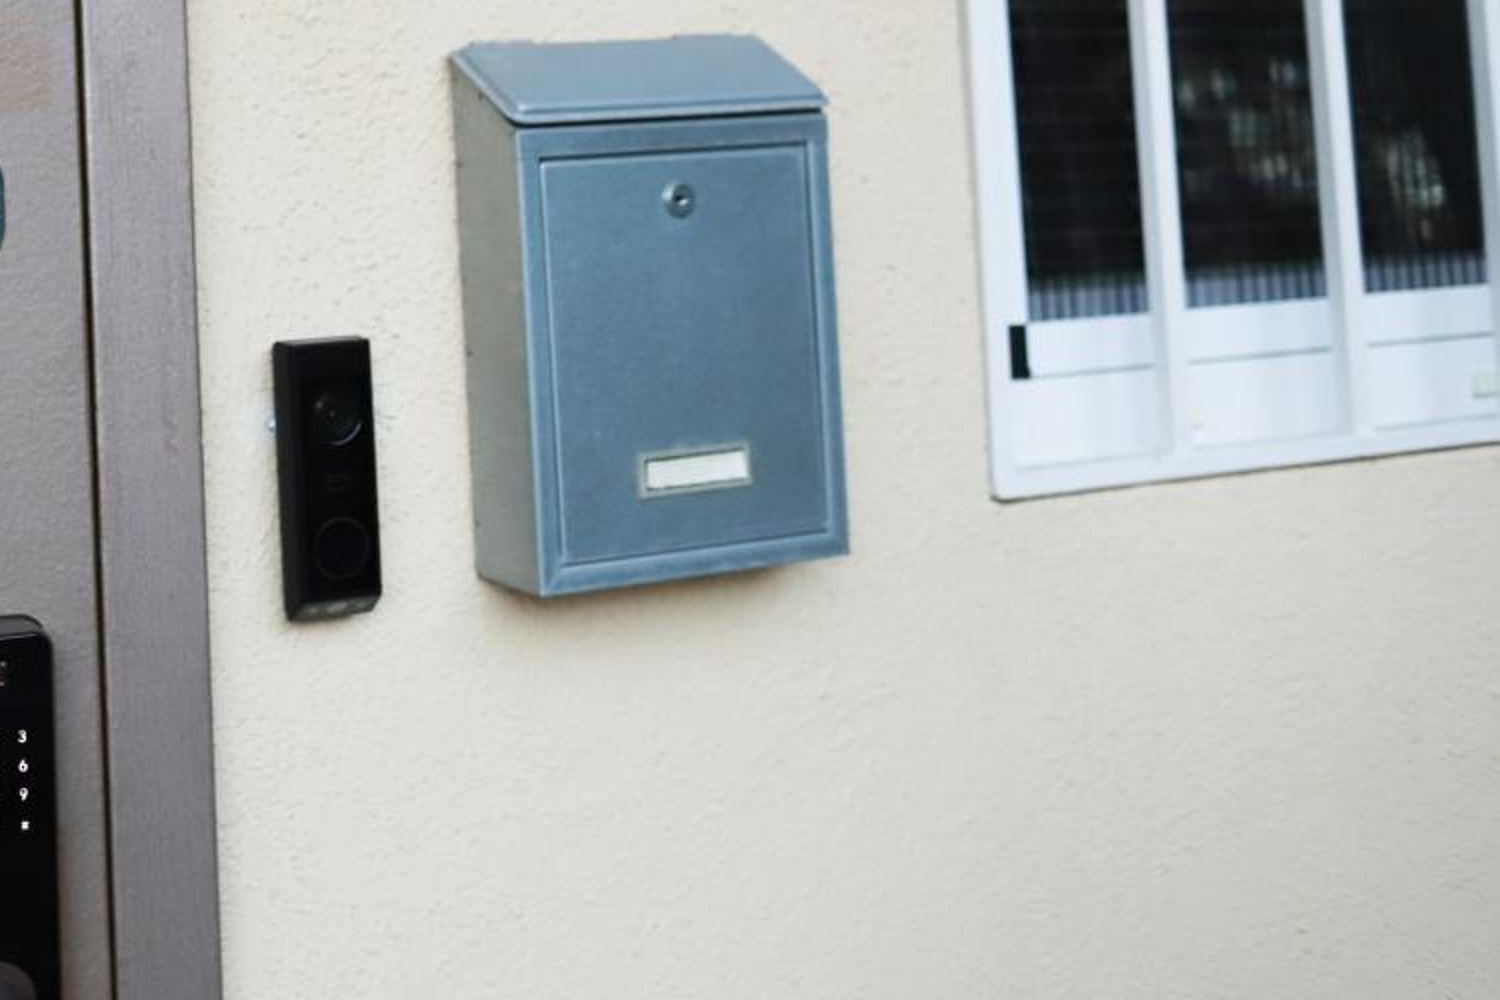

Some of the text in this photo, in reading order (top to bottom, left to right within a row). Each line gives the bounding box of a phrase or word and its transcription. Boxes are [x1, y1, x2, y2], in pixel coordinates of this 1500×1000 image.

[17, 729, 28, 744] 3
[18, 759, 29, 773] 6
[19, 787, 29, 801] 9
